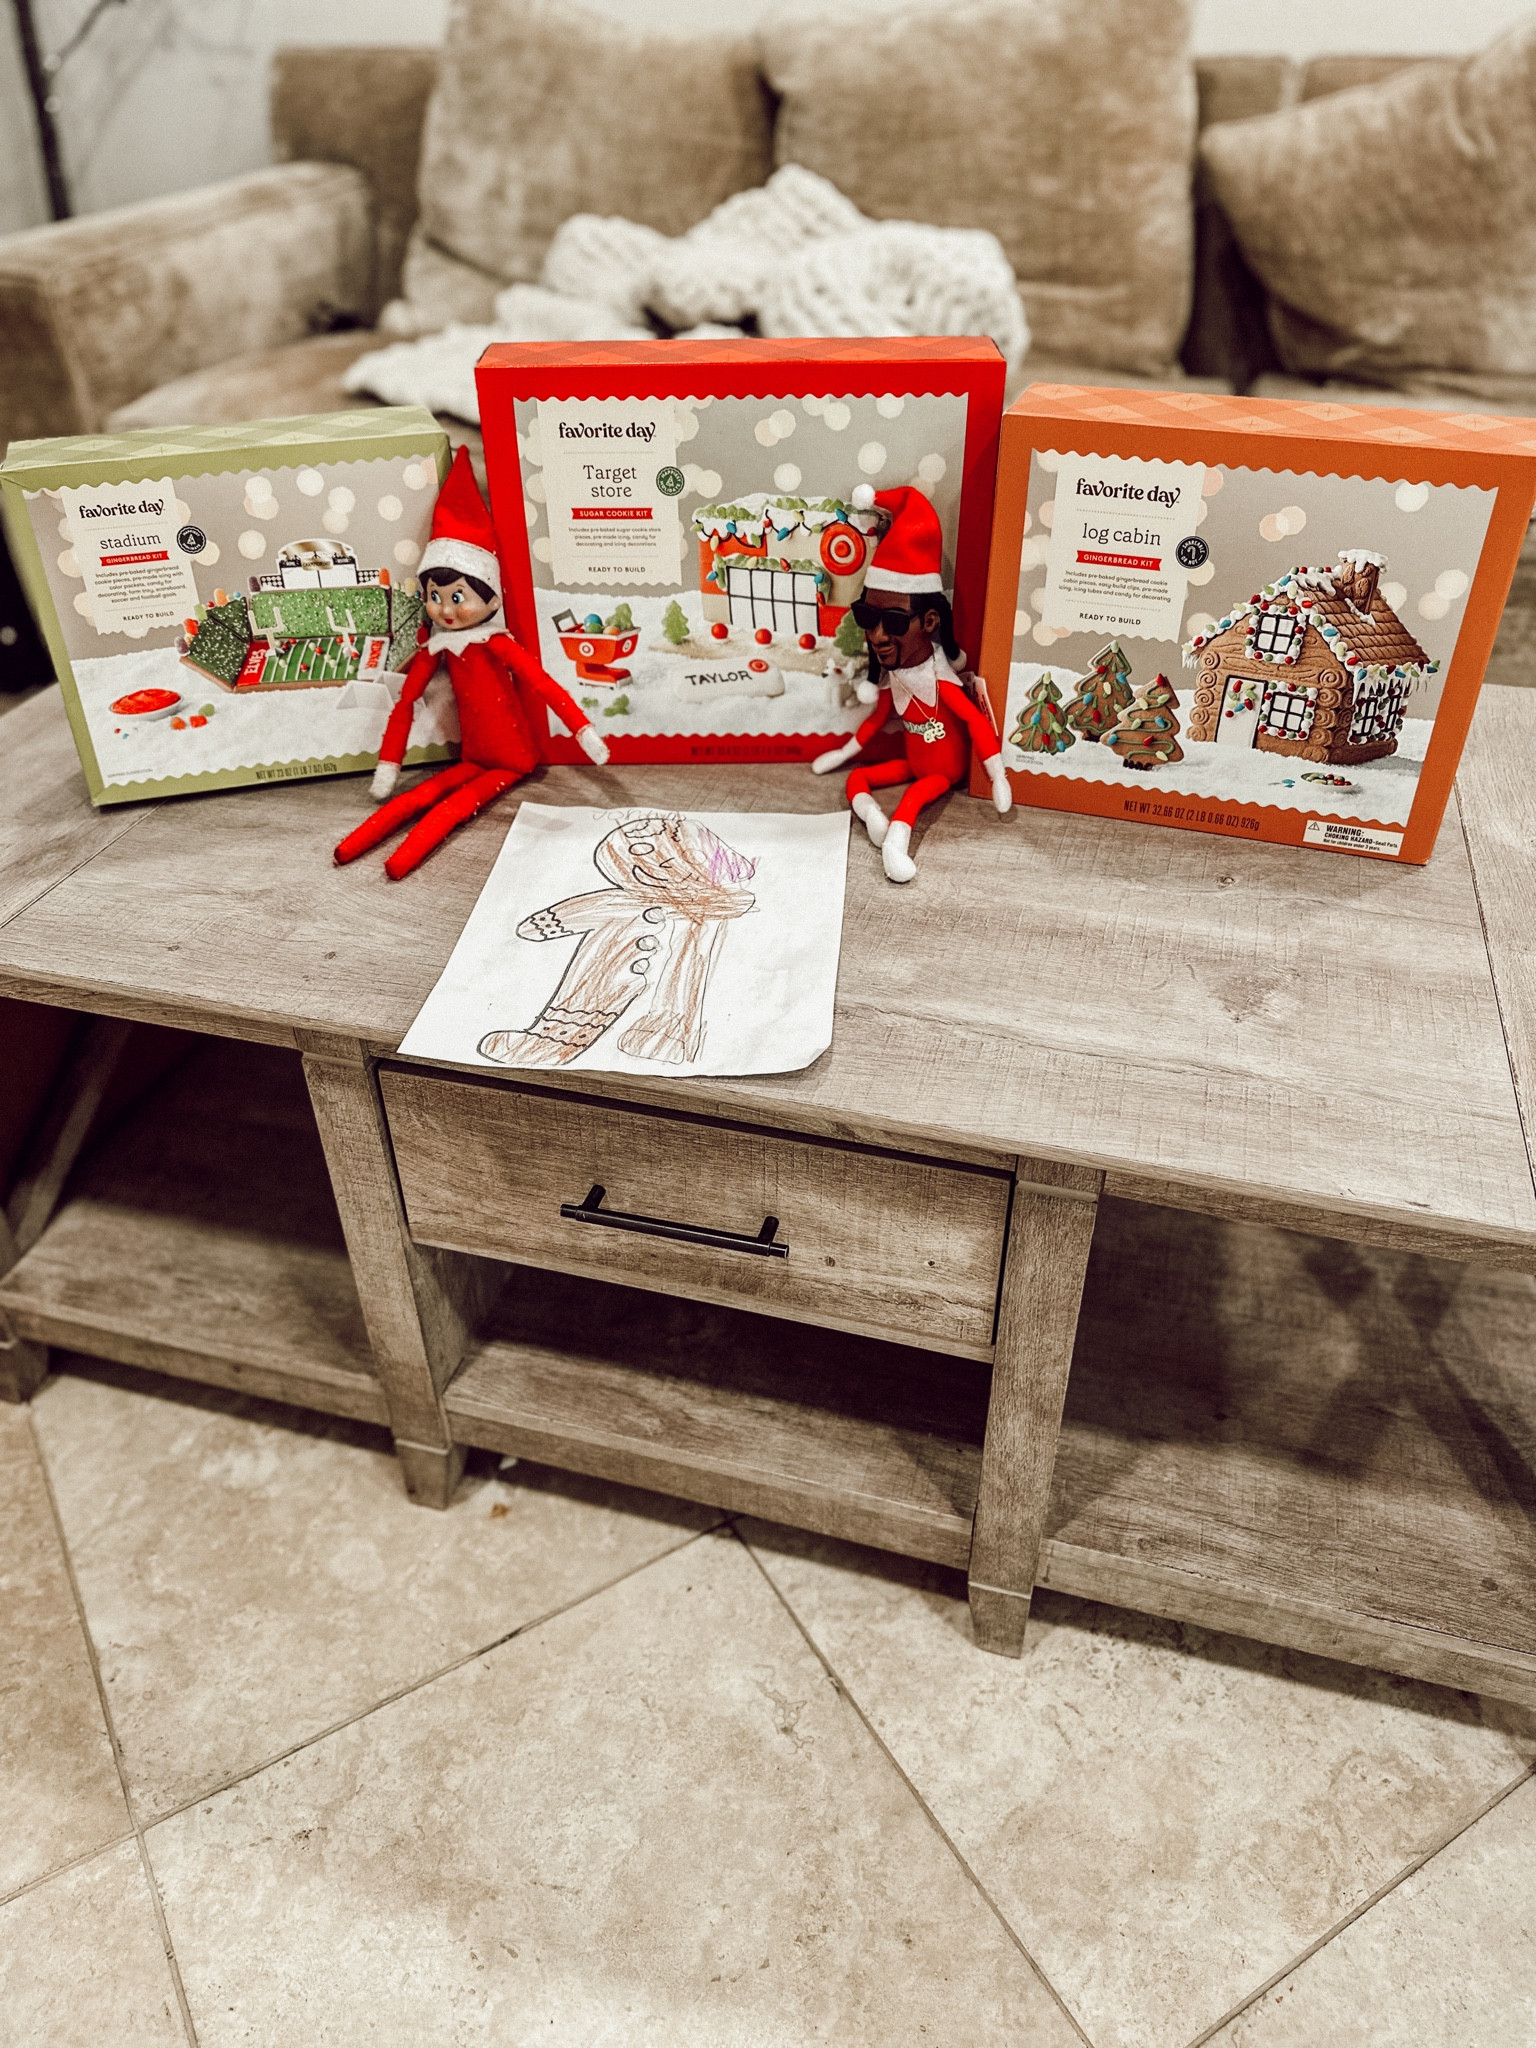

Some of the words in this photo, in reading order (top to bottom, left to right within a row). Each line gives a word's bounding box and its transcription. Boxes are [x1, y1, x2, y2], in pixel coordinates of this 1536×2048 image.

[559, 422, 623, 439] favorite
[626, 421, 656, 442] day
[583, 465, 637, 483] Target
[591, 485, 632, 498] store
[1076, 477, 1144, 500] favorite
[1147, 486, 1181, 508] day
[79, 502, 137, 519] favorite
[138, 499, 164, 516] day
[1082, 522, 1110, 545] log
[1113, 528, 1161, 546] cabin
[100, 534, 161, 550] stadium
[106, 555, 151, 565] GINGERBREAD
[1083, 553, 1139, 566] GINGERBREAD
[1140, 559, 1154, 567] KIT
[1065, 570, 1087, 578] Includes
[1088, 573, 1115, 581] pre-baked
[1116, 575, 1149, 584] gingerbread
[1079, 579, 1098, 587] pieces,
[1141, 594, 1171, 603] decorating
[1079, 612, 1104, 621] READY
[1118, 617, 1141, 625] BUILD
[244, 649, 267, 675] ELVES
[684, 670, 753, 686] TAYLOR
[255, 770, 266, 780] NET
[267, 769, 276, 779] WT
[285, 767, 292, 776] OZ
[300, 765, 308, 775] LB
[1124, 800, 1138, 812] NET
[1139, 802, 1152, 814] WT
[1152, 804, 1173, 818] 32.66
[1174, 807, 1186, 819] OZ
[1186, 808, 1195, 821] (2
[1195, 810, 1206, 822] LB
[1207, 811, 1225, 825] 0.66
[1225, 814, 1239, 828] OZ)
[1240, 817, 1260, 832] 926g
[1324, 832, 1349, 841] CHOKING
[1326, 824, 1365, 837] WARNING:
